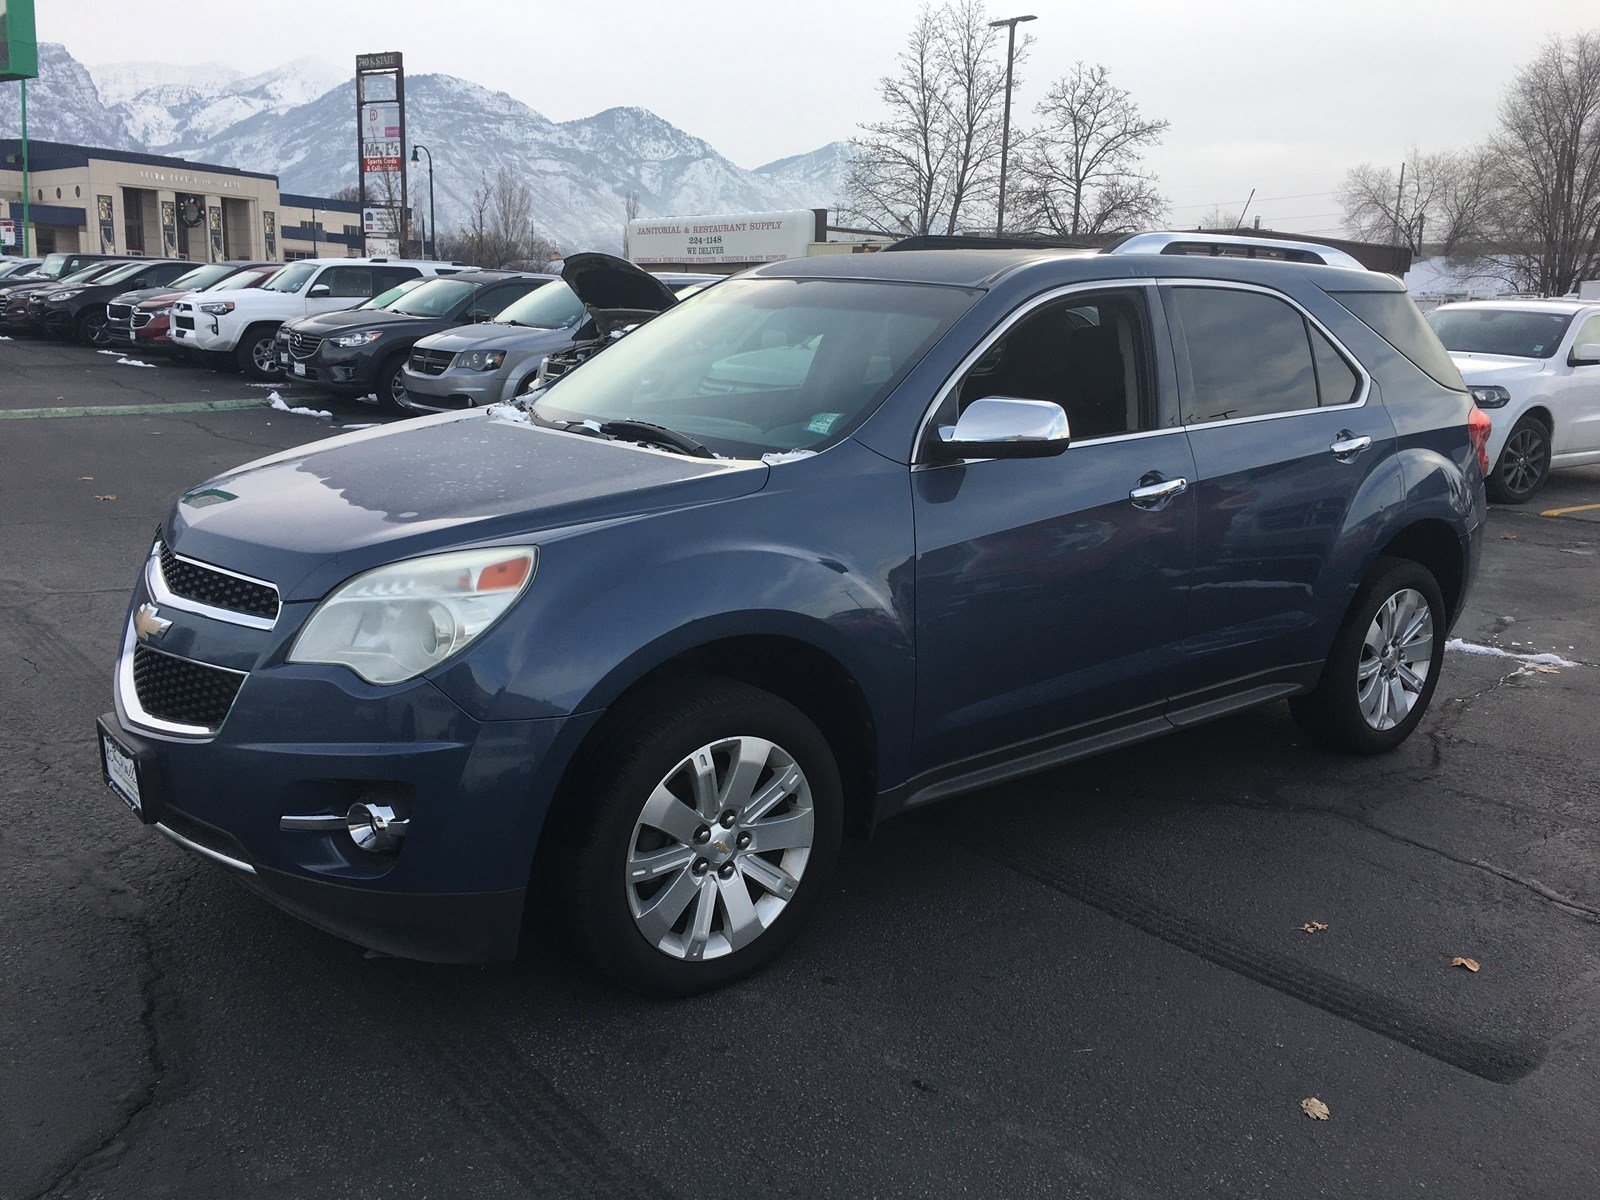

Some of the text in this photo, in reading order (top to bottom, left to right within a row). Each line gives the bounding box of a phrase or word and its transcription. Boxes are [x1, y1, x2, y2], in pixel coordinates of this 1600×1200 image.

[376, 55, 395, 67] STATE
[367, 158, 383, 166] Sports
[637, 221, 782, 235] JANITORIAL & RESTAURANT SUPPLY
[686, 246, 724, 255] WE DELIVER
